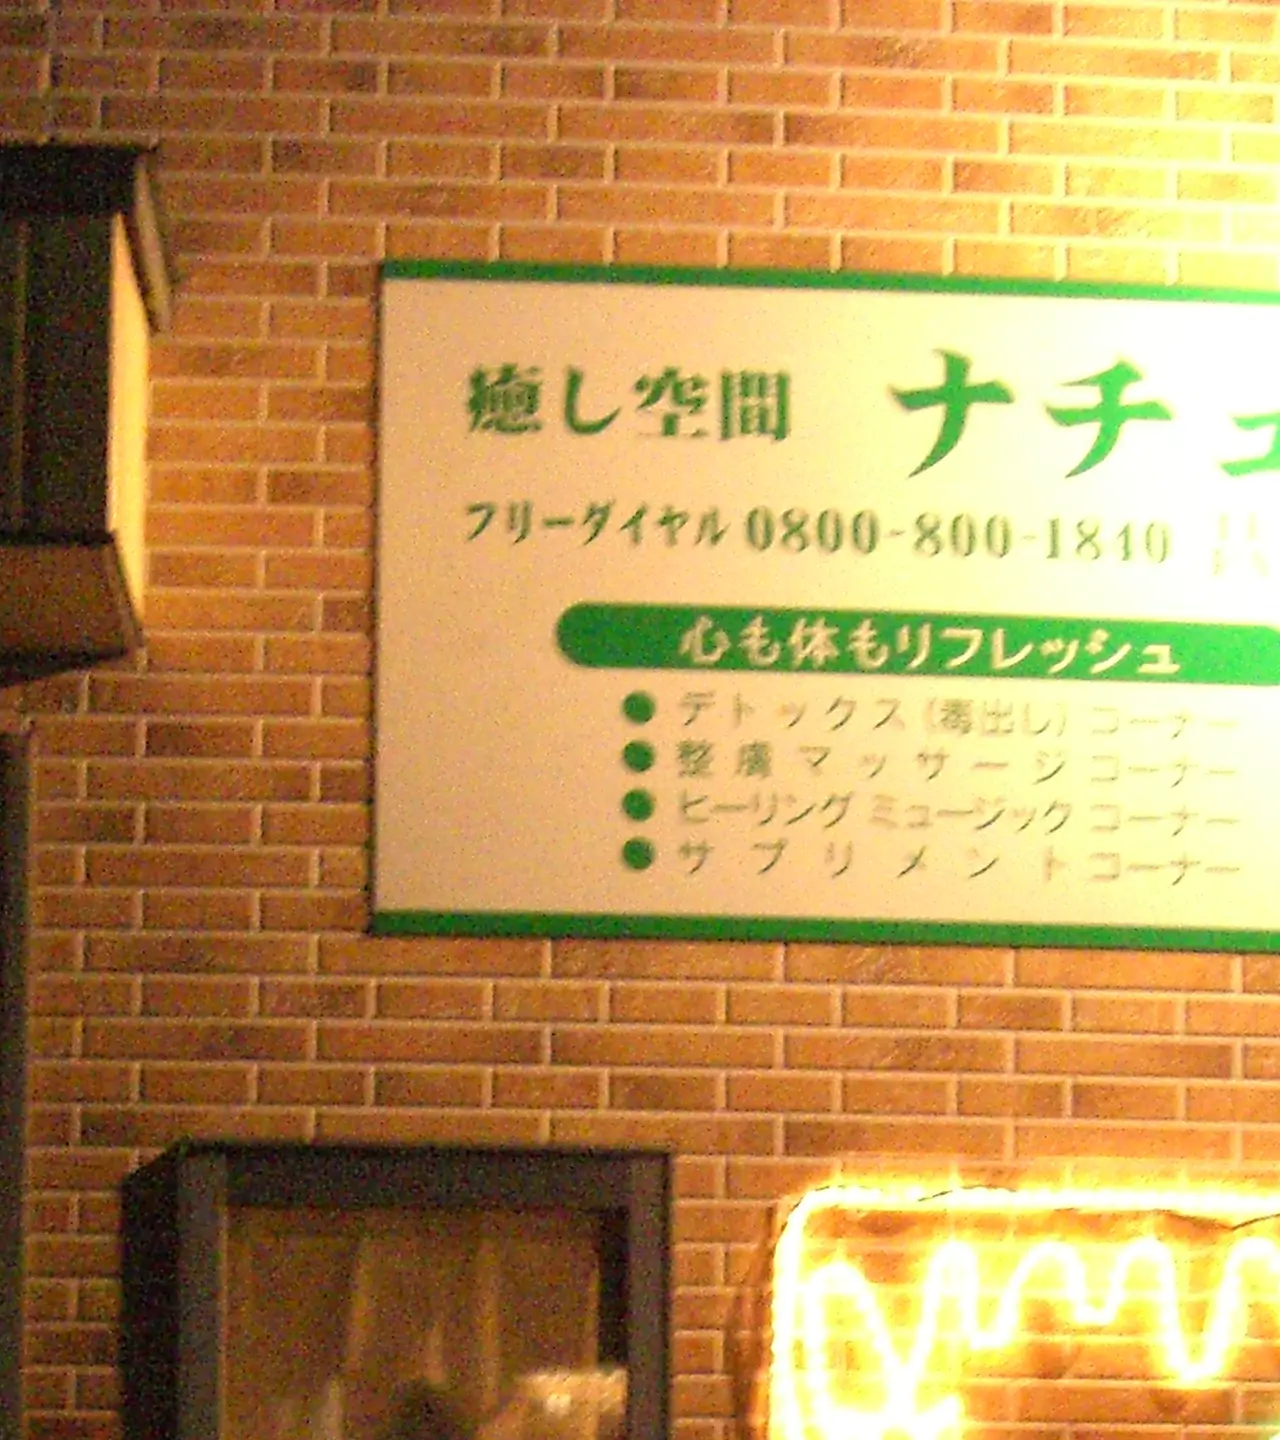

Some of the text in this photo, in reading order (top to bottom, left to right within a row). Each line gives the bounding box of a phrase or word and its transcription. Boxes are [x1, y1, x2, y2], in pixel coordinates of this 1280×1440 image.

[466, 362, 792, 442] 癒し空間
[466, 501, 728, 548] フリーダイヤル
[679, 615, 1182, 675] 心も体もリフレッシュ
